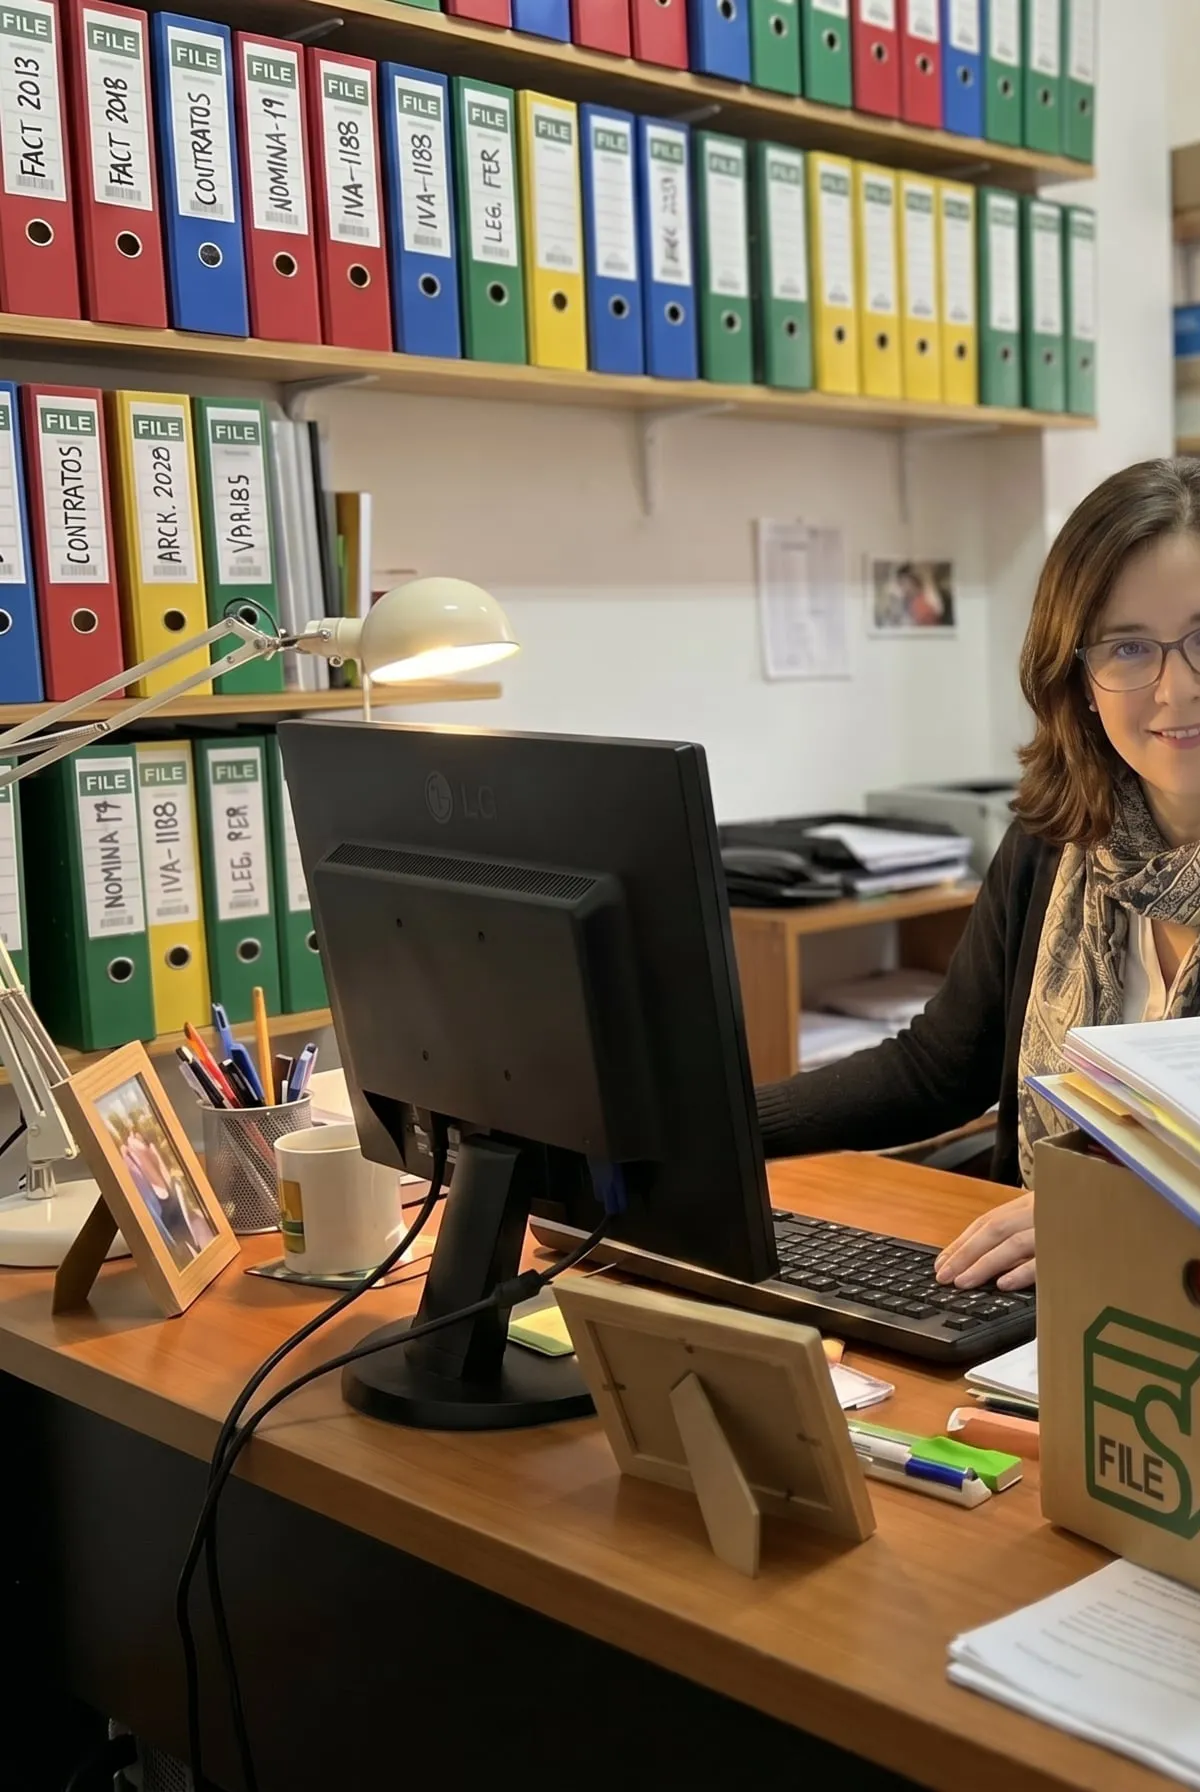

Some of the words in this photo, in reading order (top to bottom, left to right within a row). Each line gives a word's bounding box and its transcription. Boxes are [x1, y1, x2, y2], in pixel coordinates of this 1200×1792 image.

[2, 13, 48, 36] FILE
[93, 29, 136, 53] FILE
[176, 47, 218, 69] FILE
[14, 56, 42, 110] 2013
[252, 61, 292, 83] FILE
[103, 77, 129, 124] 2018
[328, 79, 366, 100] FILE
[403, 95, 438, 115] FILE
[472, 107, 505, 127] FILE
[538, 120, 571, 140] FILE
[596, 131, 626, 150] FILE
[20, 120, 46, 178] FACT
[109, 133, 135, 187] FACT
[262, 97, 293, 212] NOMINA-19
[652, 141, 683, 162] FILE
[337, 120, 366, 218] IVA-1188
[480, 148, 501, 189] FER
[411, 133, 438, 229] IVA-1188
[46, 413, 92, 432] FILE
[137, 420, 180, 437] FILE
[215, 424, 256, 441] FILE
[60, 445, 91, 564] CONTRATOS
[86, 774, 126, 790] FILE
[144, 767, 183, 783] FILE
[216, 764, 254, 779] FILE
[99, 830, 125, 909] NOMINA
[1098, 1434, 1164, 1501] FILE
